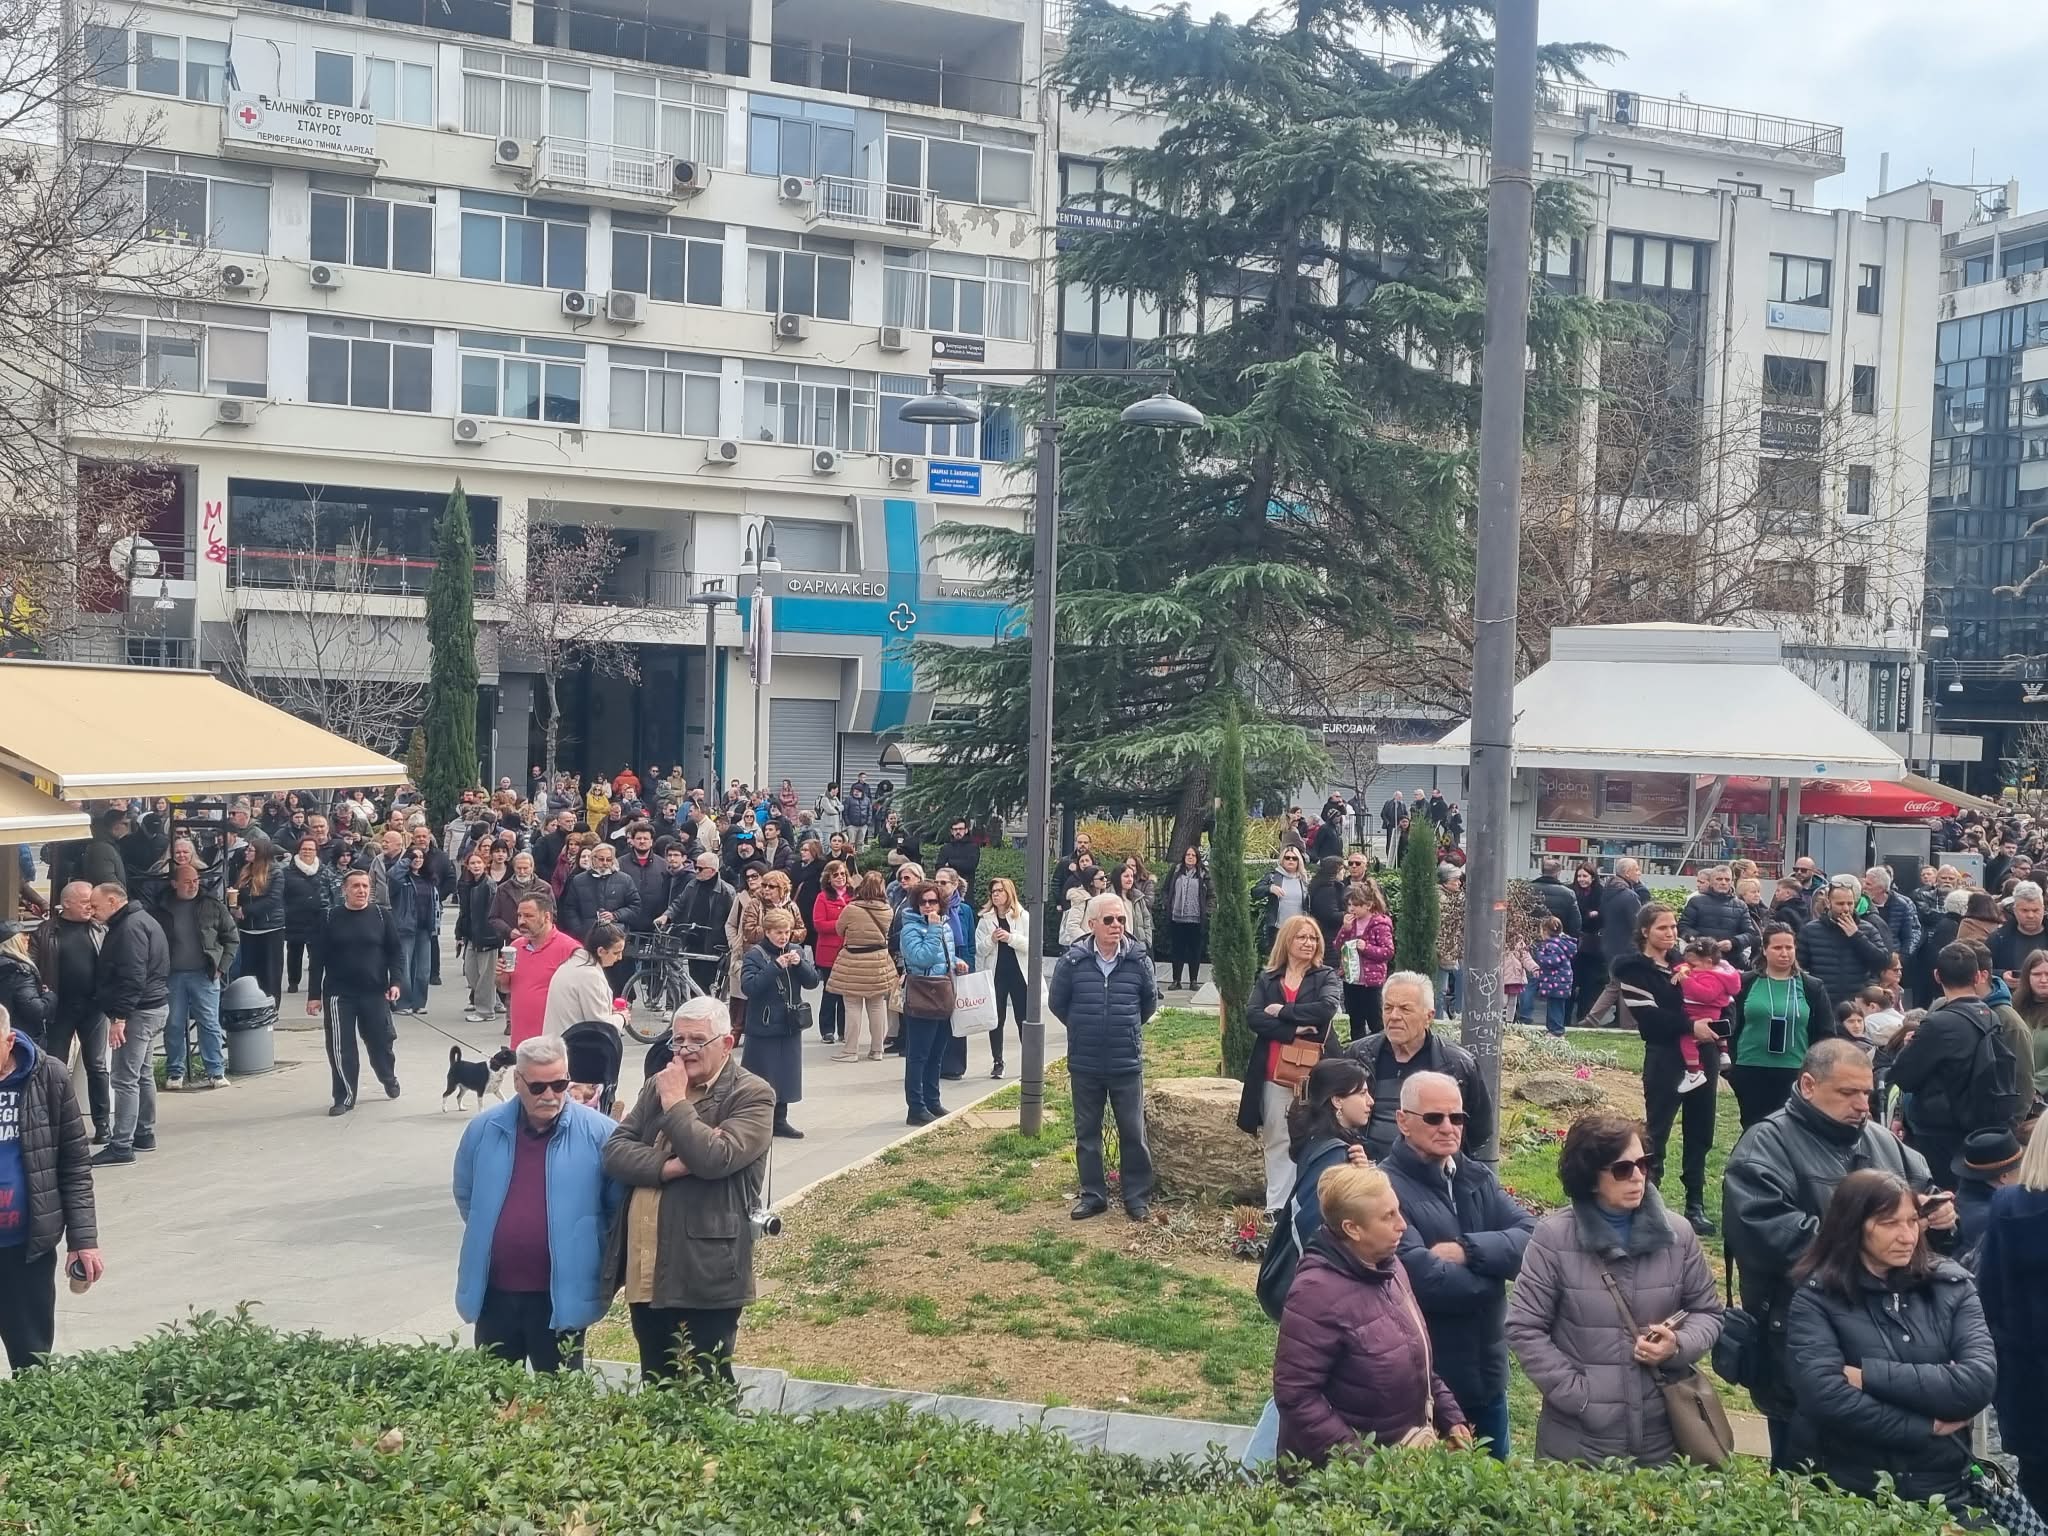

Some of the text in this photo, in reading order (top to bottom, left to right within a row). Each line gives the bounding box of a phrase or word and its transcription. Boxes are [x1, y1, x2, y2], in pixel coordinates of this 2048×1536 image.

[265, 100, 374, 125] ΕΛΛΗΝΙΚΟΣ ΕΡΥΘΡΟΣ
[298, 120, 342, 136] ΣΤΑΥΡΟΣ
[257, 131, 374, 155] ΠΕΡΙΦΕΡΕΙΑΚΟ ΤΜΗΜΑ ΛΑΡΙΣΑΣ
[788, 579, 886, 597] ΦΑΡΜΑΚΕΙΟ
[1322, 723, 1377, 734] EUROBANK
